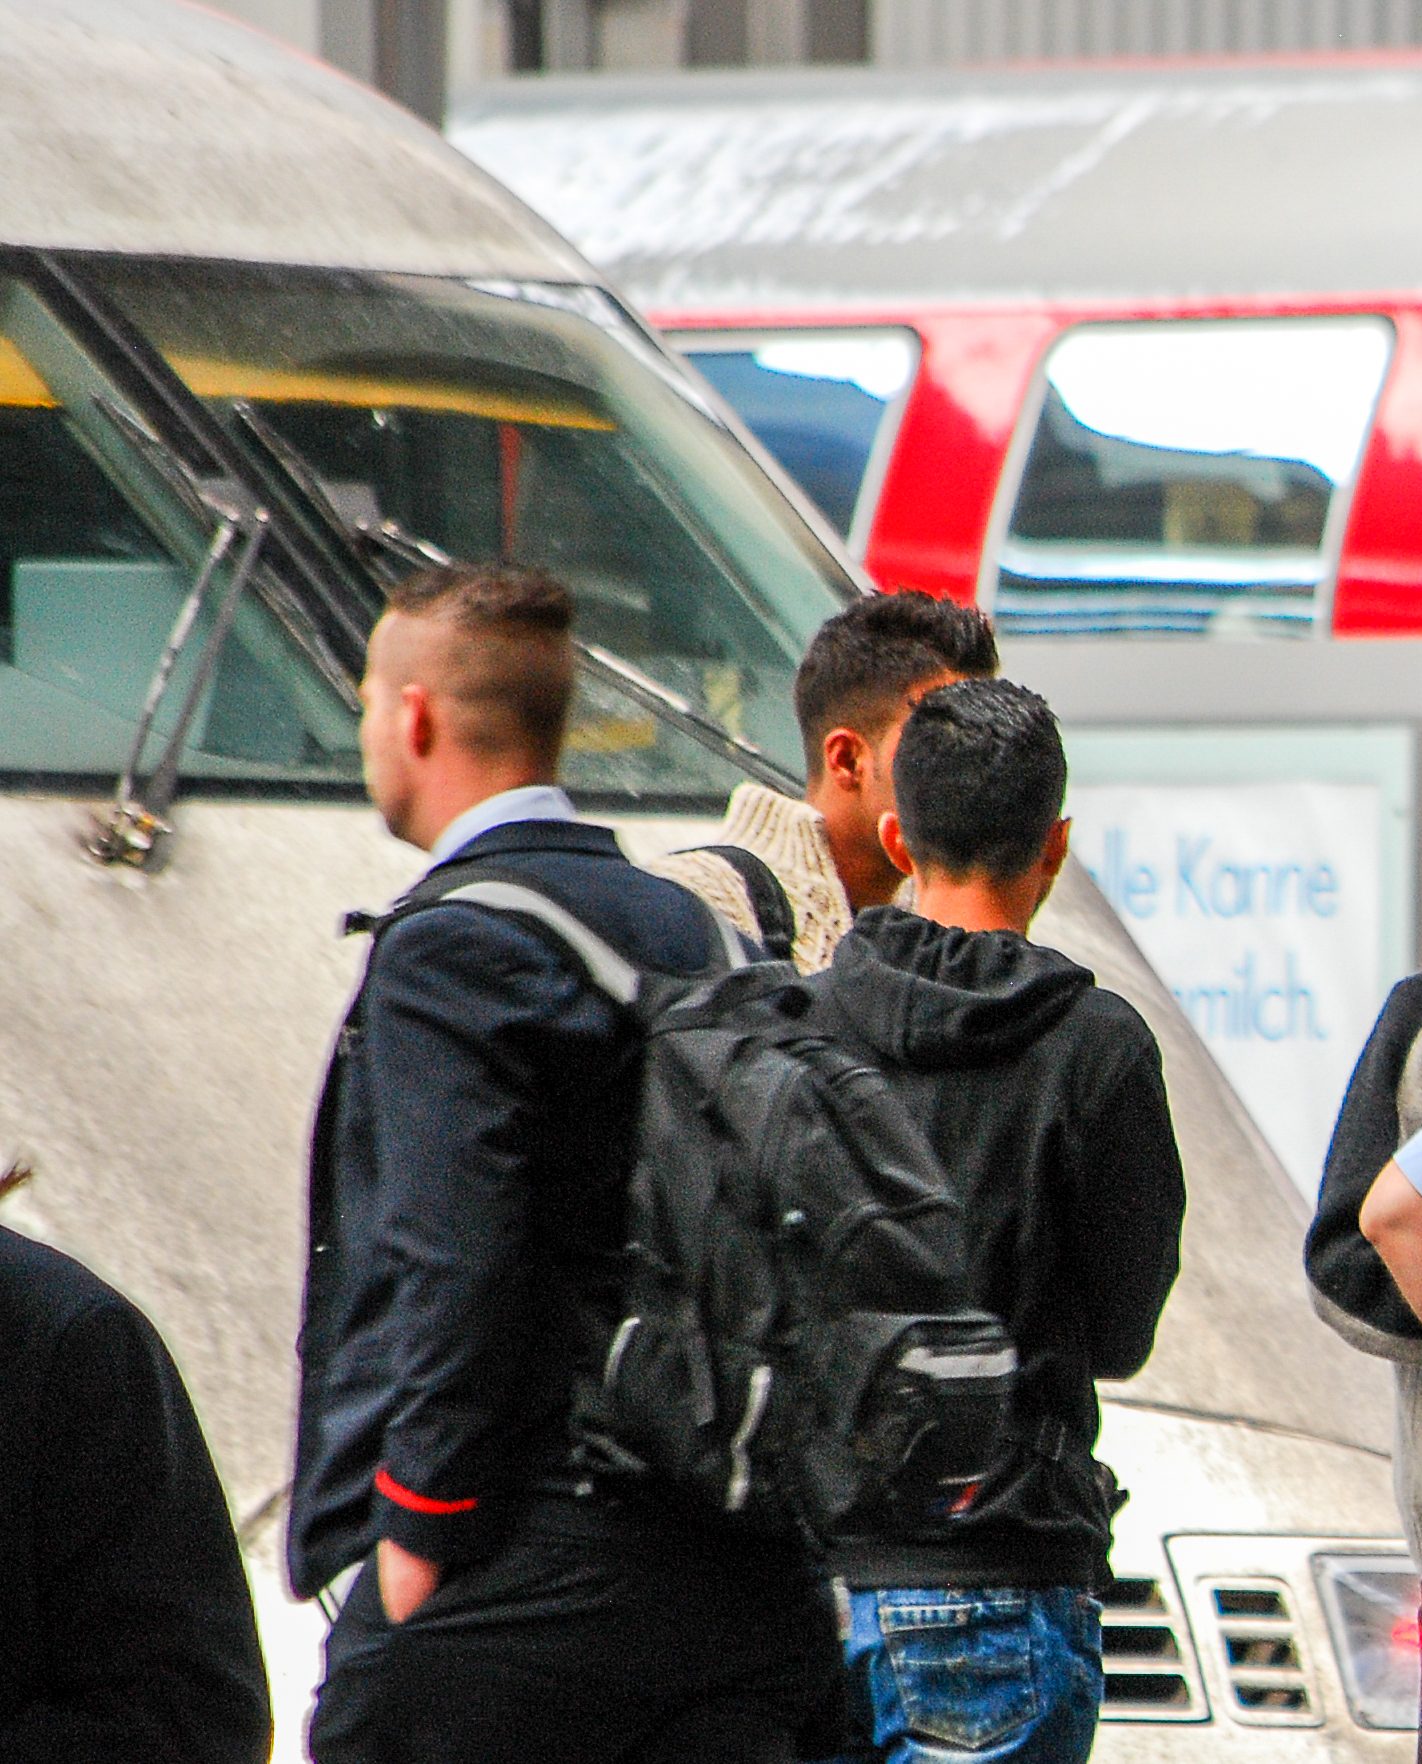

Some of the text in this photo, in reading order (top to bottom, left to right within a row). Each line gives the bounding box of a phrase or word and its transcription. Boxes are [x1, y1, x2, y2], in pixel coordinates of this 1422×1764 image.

[1087, 827, 1340, 918] lle Kanne
[1173, 946, 1328, 1041] milch.
